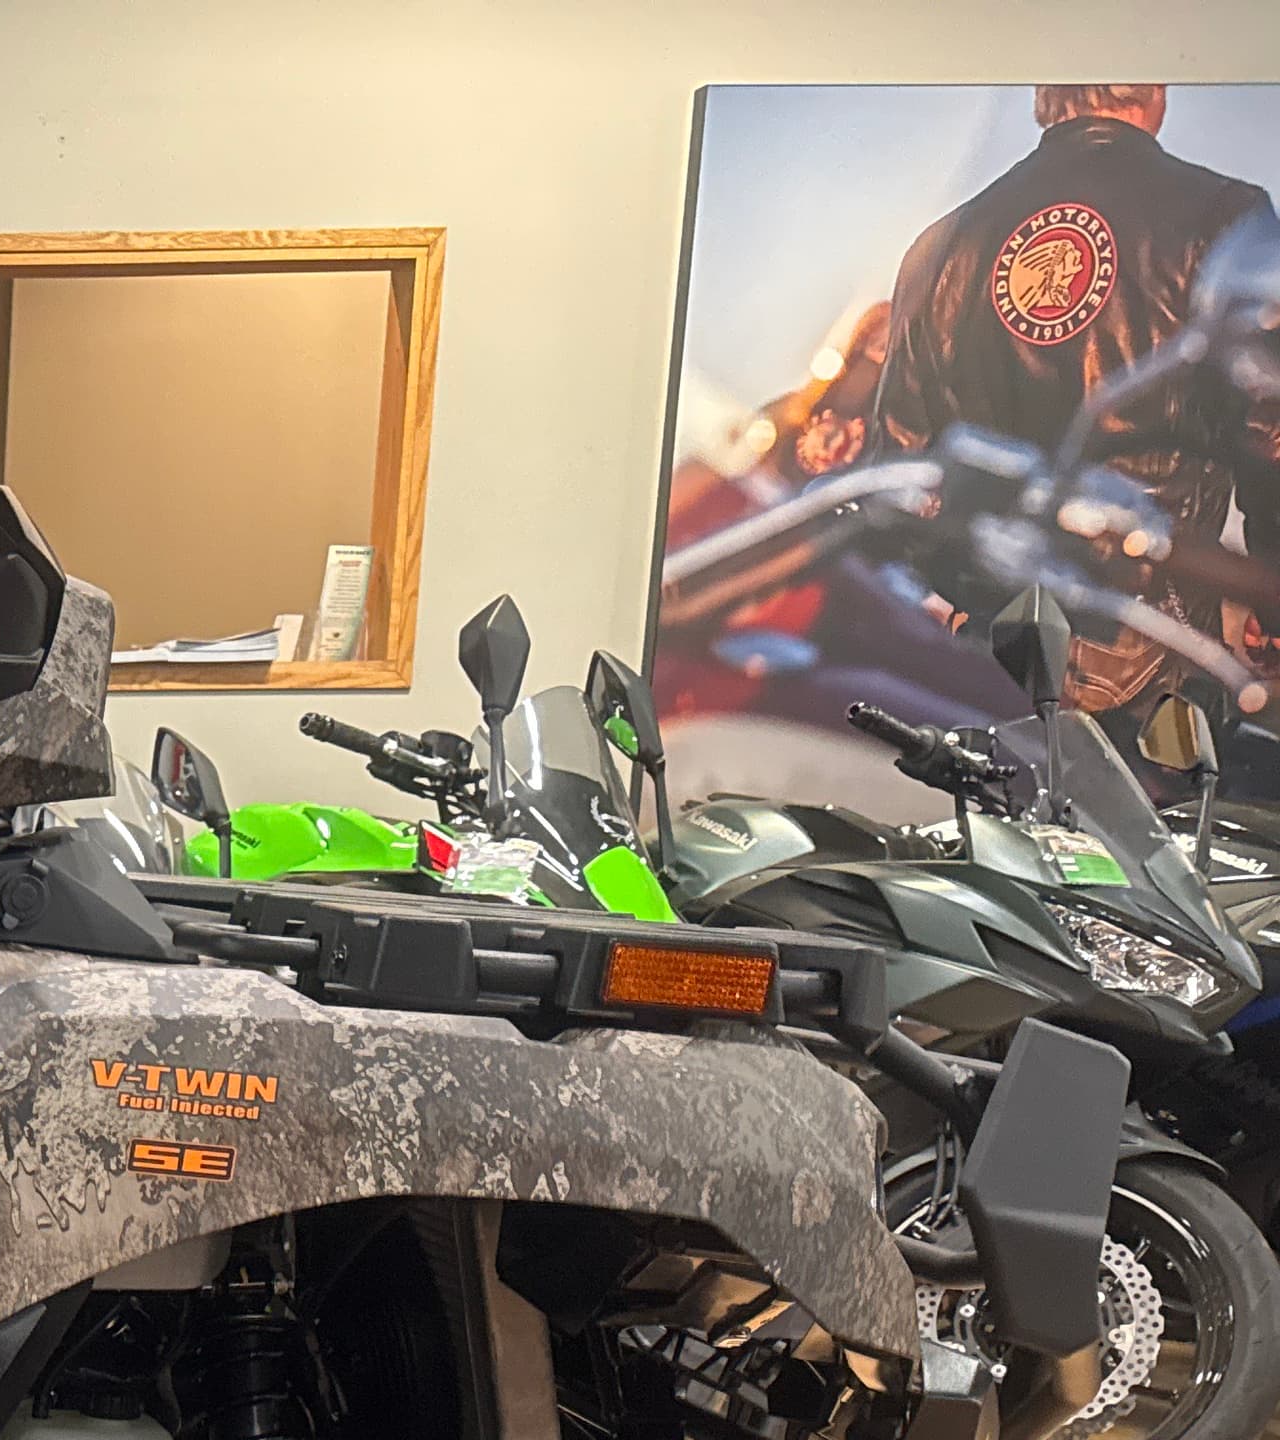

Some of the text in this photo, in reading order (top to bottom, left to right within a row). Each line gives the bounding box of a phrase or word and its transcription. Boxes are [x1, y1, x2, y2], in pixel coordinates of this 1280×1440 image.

[996, 208, 1113, 322] INDIAN MOTORCYCLE
[1032, 320, 1075, 340] 1901
[688, 813, 759, 852] Kawasaki
[91, 1060, 279, 1103] V-TWIN
[119, 1093, 260, 1120] Fuel Injected
[132, 1144, 231, 1176] SE
